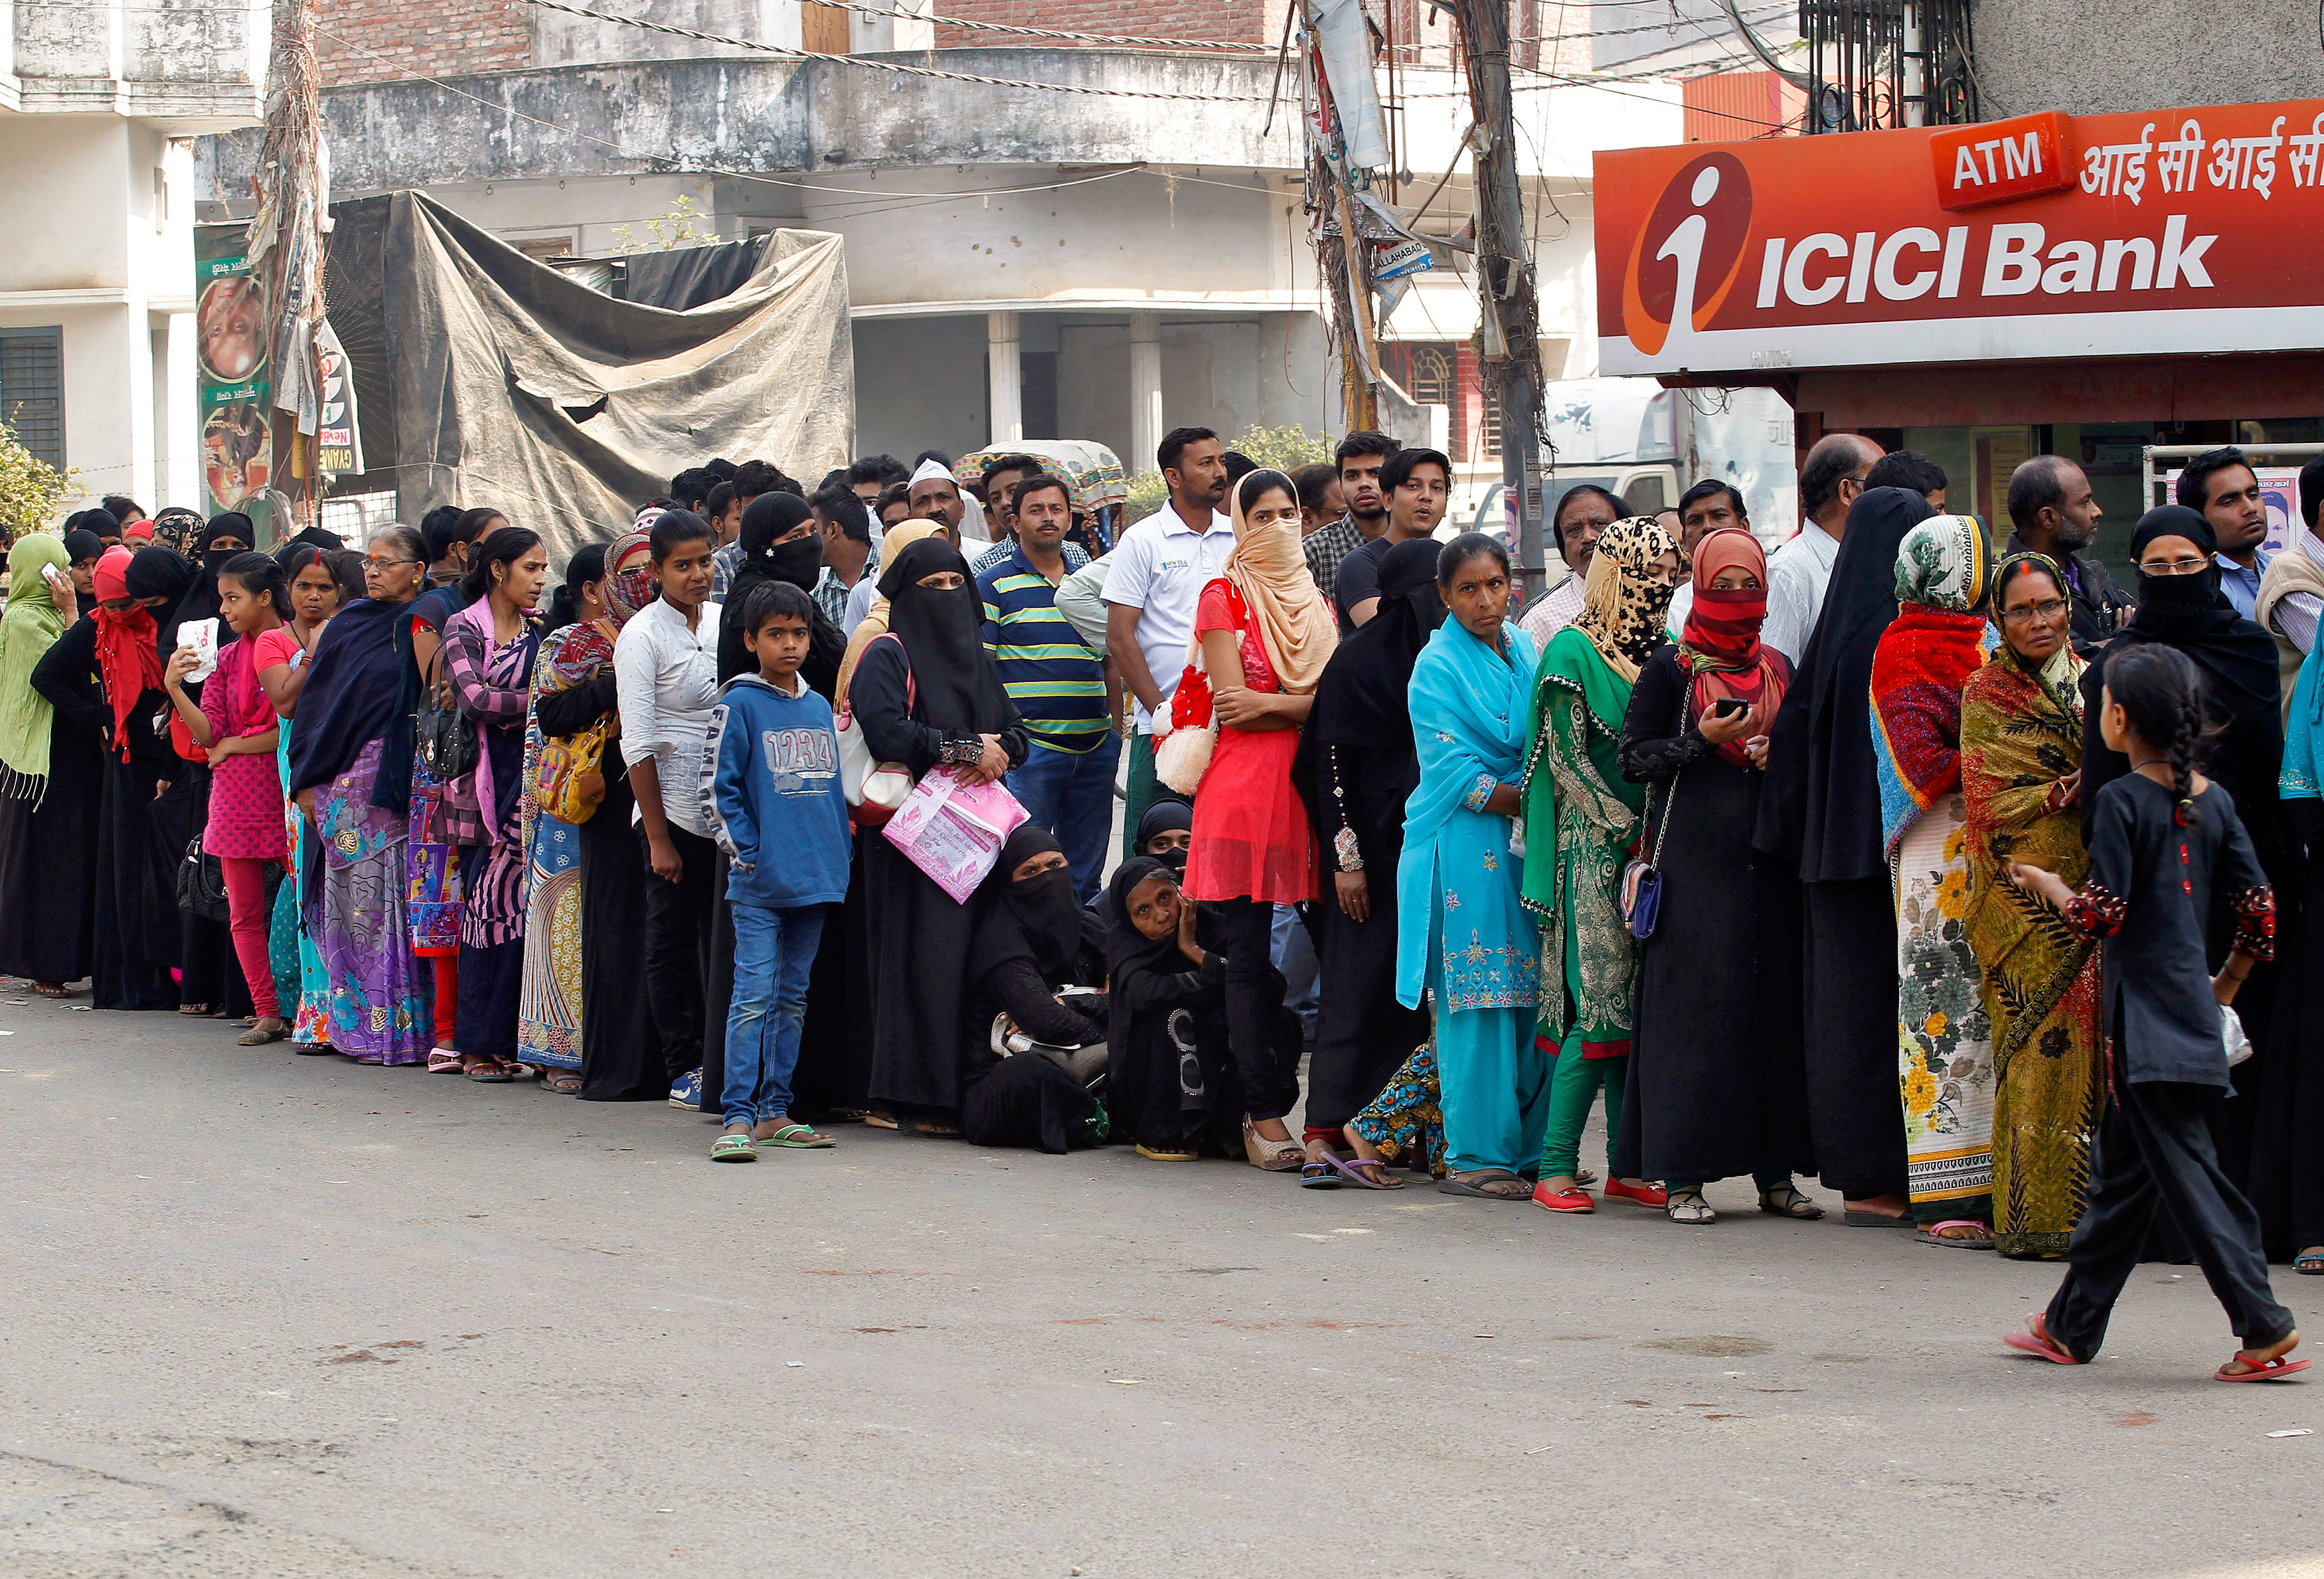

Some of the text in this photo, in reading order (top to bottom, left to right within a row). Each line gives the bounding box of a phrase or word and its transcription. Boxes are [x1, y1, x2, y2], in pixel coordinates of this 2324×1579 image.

[1953, 131, 2042, 190] ATM
[2079, 123, 2156, 207] आई
[2157, 118, 2206, 194] सी
[2206, 116, 2287, 201] आई
[1756, 214, 2218, 309] ICICI Bank
[216, 391, 232, 401] राणा
[767, 730, 835, 771] 1234
[938, 831, 961, 851] Curtain
[930, 865, 944, 878] Buksh
